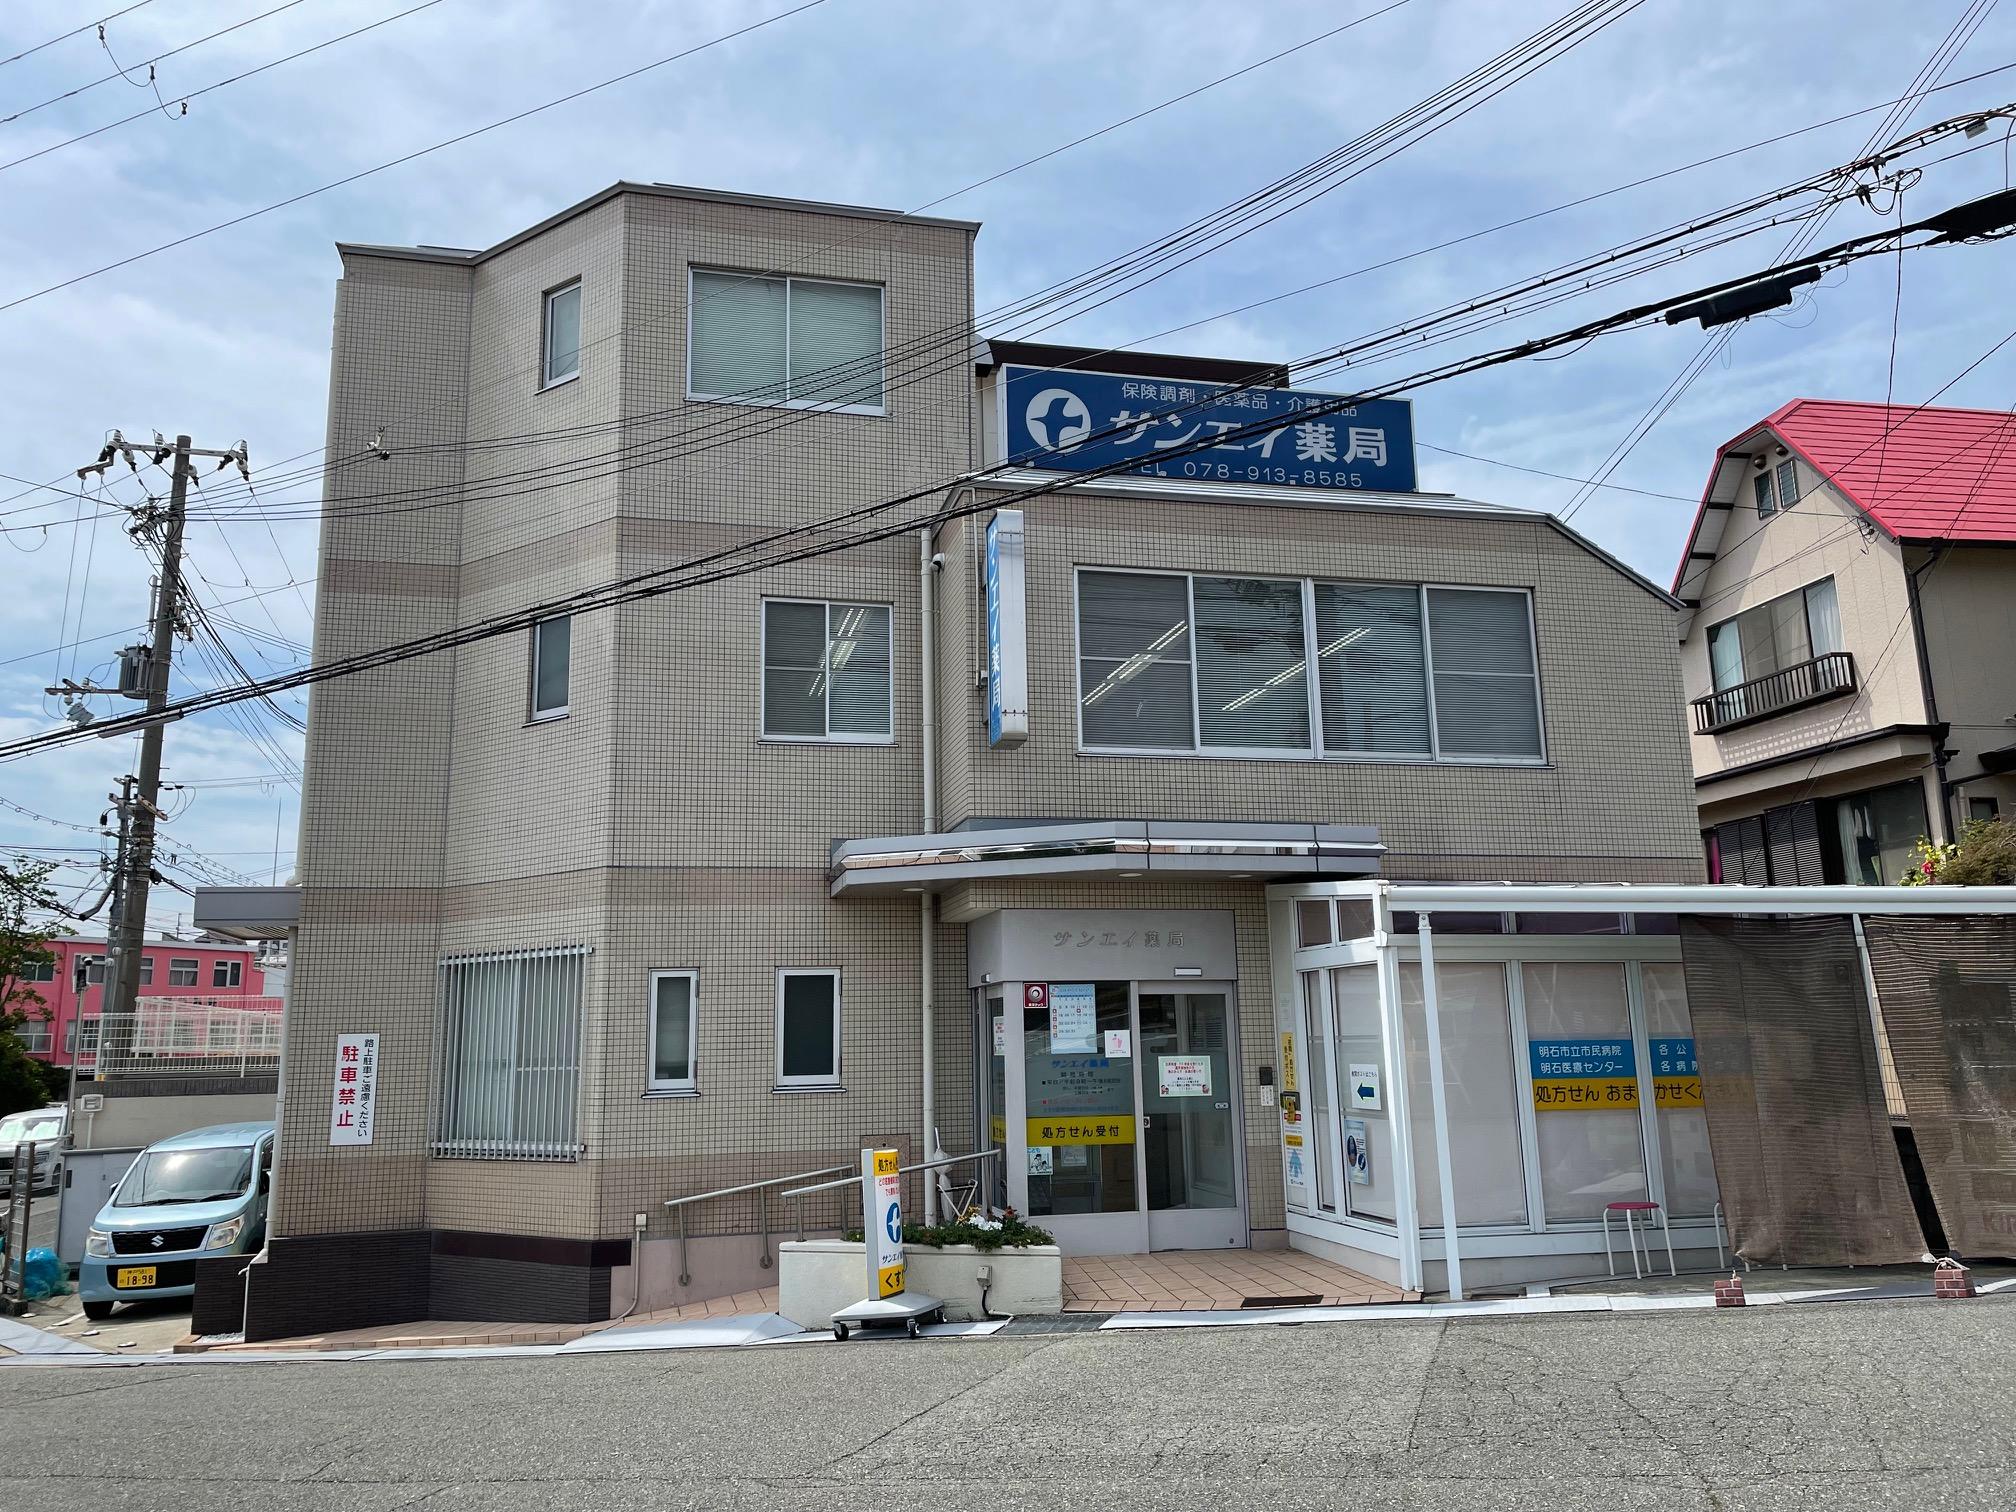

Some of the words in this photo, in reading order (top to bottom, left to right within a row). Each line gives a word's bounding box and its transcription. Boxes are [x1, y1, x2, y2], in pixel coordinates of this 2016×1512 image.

[1109, 410, 1388, 468] サンエイ薬局
[1184, 461, 1363, 487] 078-913-8585
[1053, 930, 1185, 948] サンエイ薬局
[1538, 1045, 1622, 1058] 明石市立市民病院
[1540, 1061, 1624, 1074] 明石医療センター
[336, 1045, 359, 1127] 駐車禁止
[357, 1039, 375, 1137] 路上駐車ご遠慮ください
[1535, 1084, 1600, 1103] 処方せん
[1041, 1125, 1120, 1139] 処方せん受付
